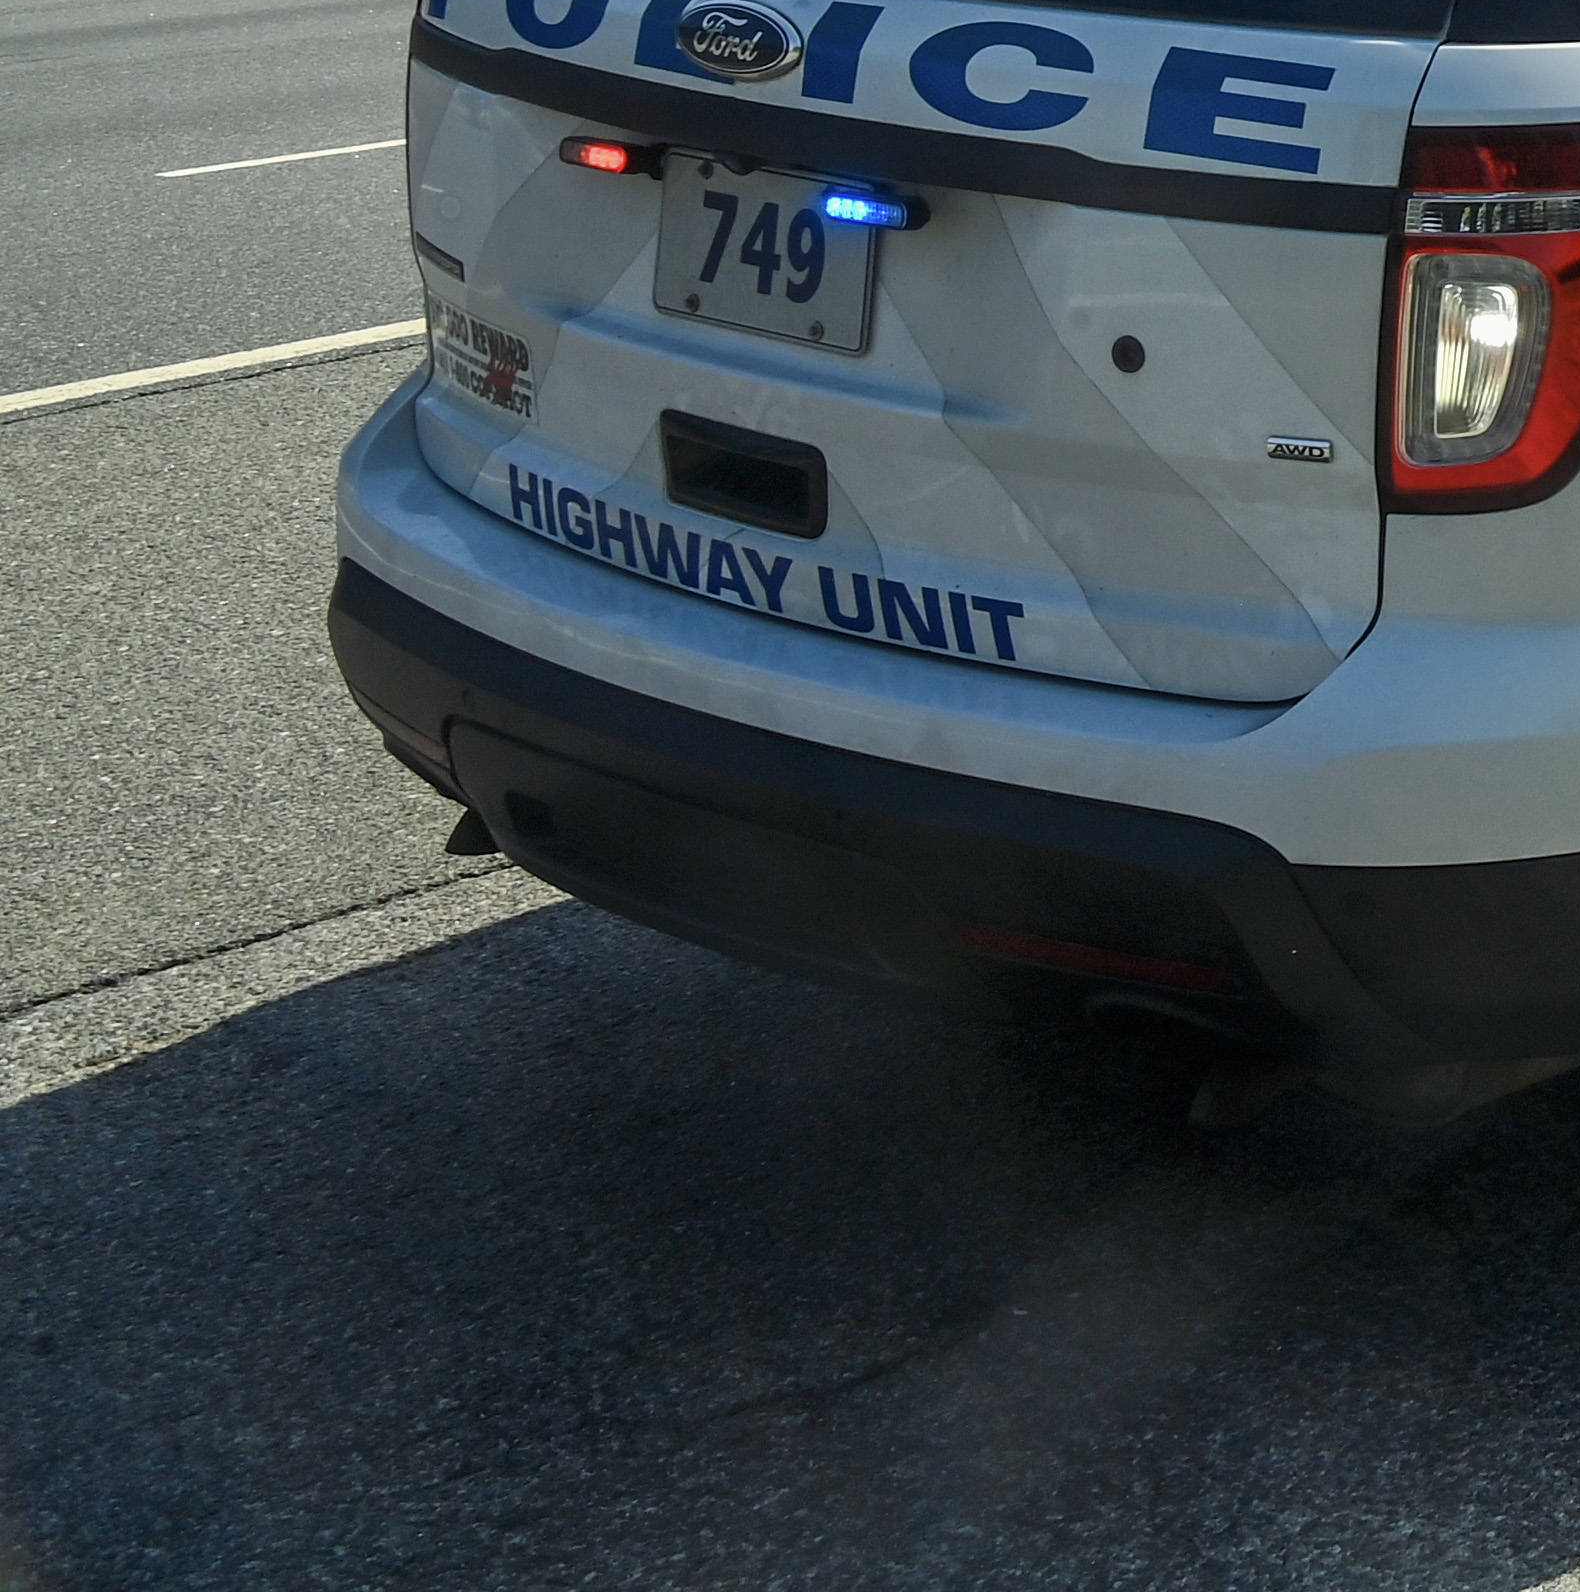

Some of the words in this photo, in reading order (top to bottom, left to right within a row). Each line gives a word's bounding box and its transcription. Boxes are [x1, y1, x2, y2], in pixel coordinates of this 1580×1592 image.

[692, 11, 763, 63] Ford
[699, 190, 826, 304] 749
[1272, 443, 1325, 458] AWD
[508, 463, 793, 613] HIGHWAY
[817, 565, 1024, 661] UNIT
